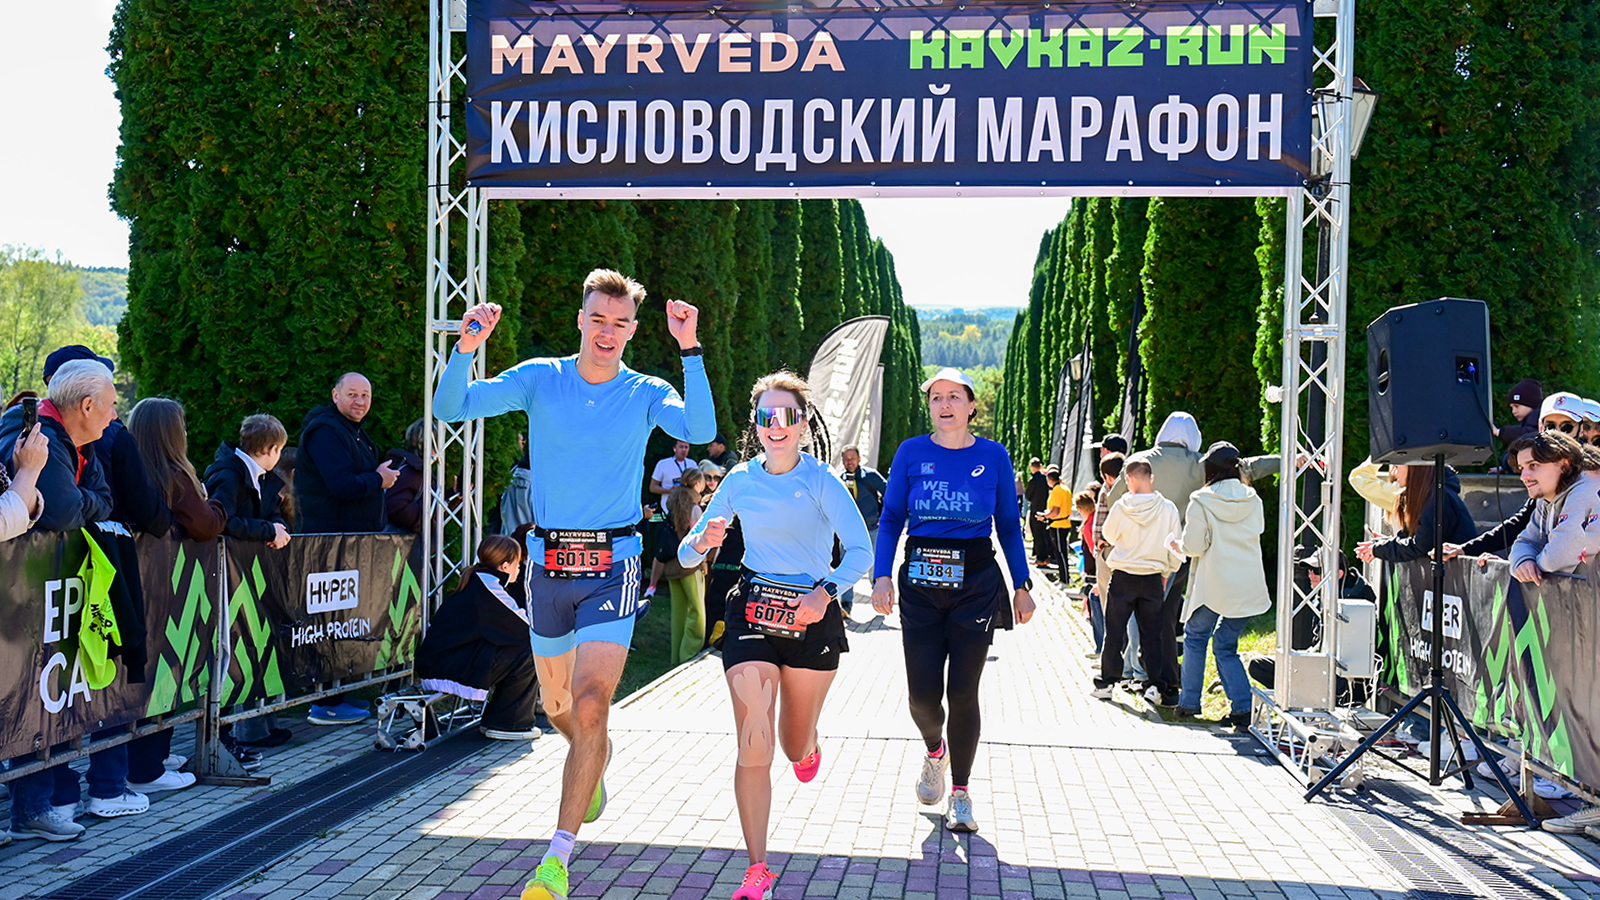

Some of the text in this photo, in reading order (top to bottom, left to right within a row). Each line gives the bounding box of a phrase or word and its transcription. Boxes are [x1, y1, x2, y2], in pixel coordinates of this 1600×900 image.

[491, 31, 846, 75] MAYRVEDA
[490, 84, 1283, 171] КИСЛОВОДСКИЙ МАРАФОН
[922, 480, 949, 492] WE
[914, 499, 974, 512] IN ART
[931, 490, 970, 502] RUN
[556, 551, 600, 567] 6015
[919, 563, 953, 578] 1384
[310, 576, 356, 605] HYPER
[761, 586, 797, 598] MAYRVEDA
[753, 604, 796, 626] 6078
[291, 617, 371, 648] HIGH PROTEIN
[1410, 637, 1472, 676] HIGH OTEIN
